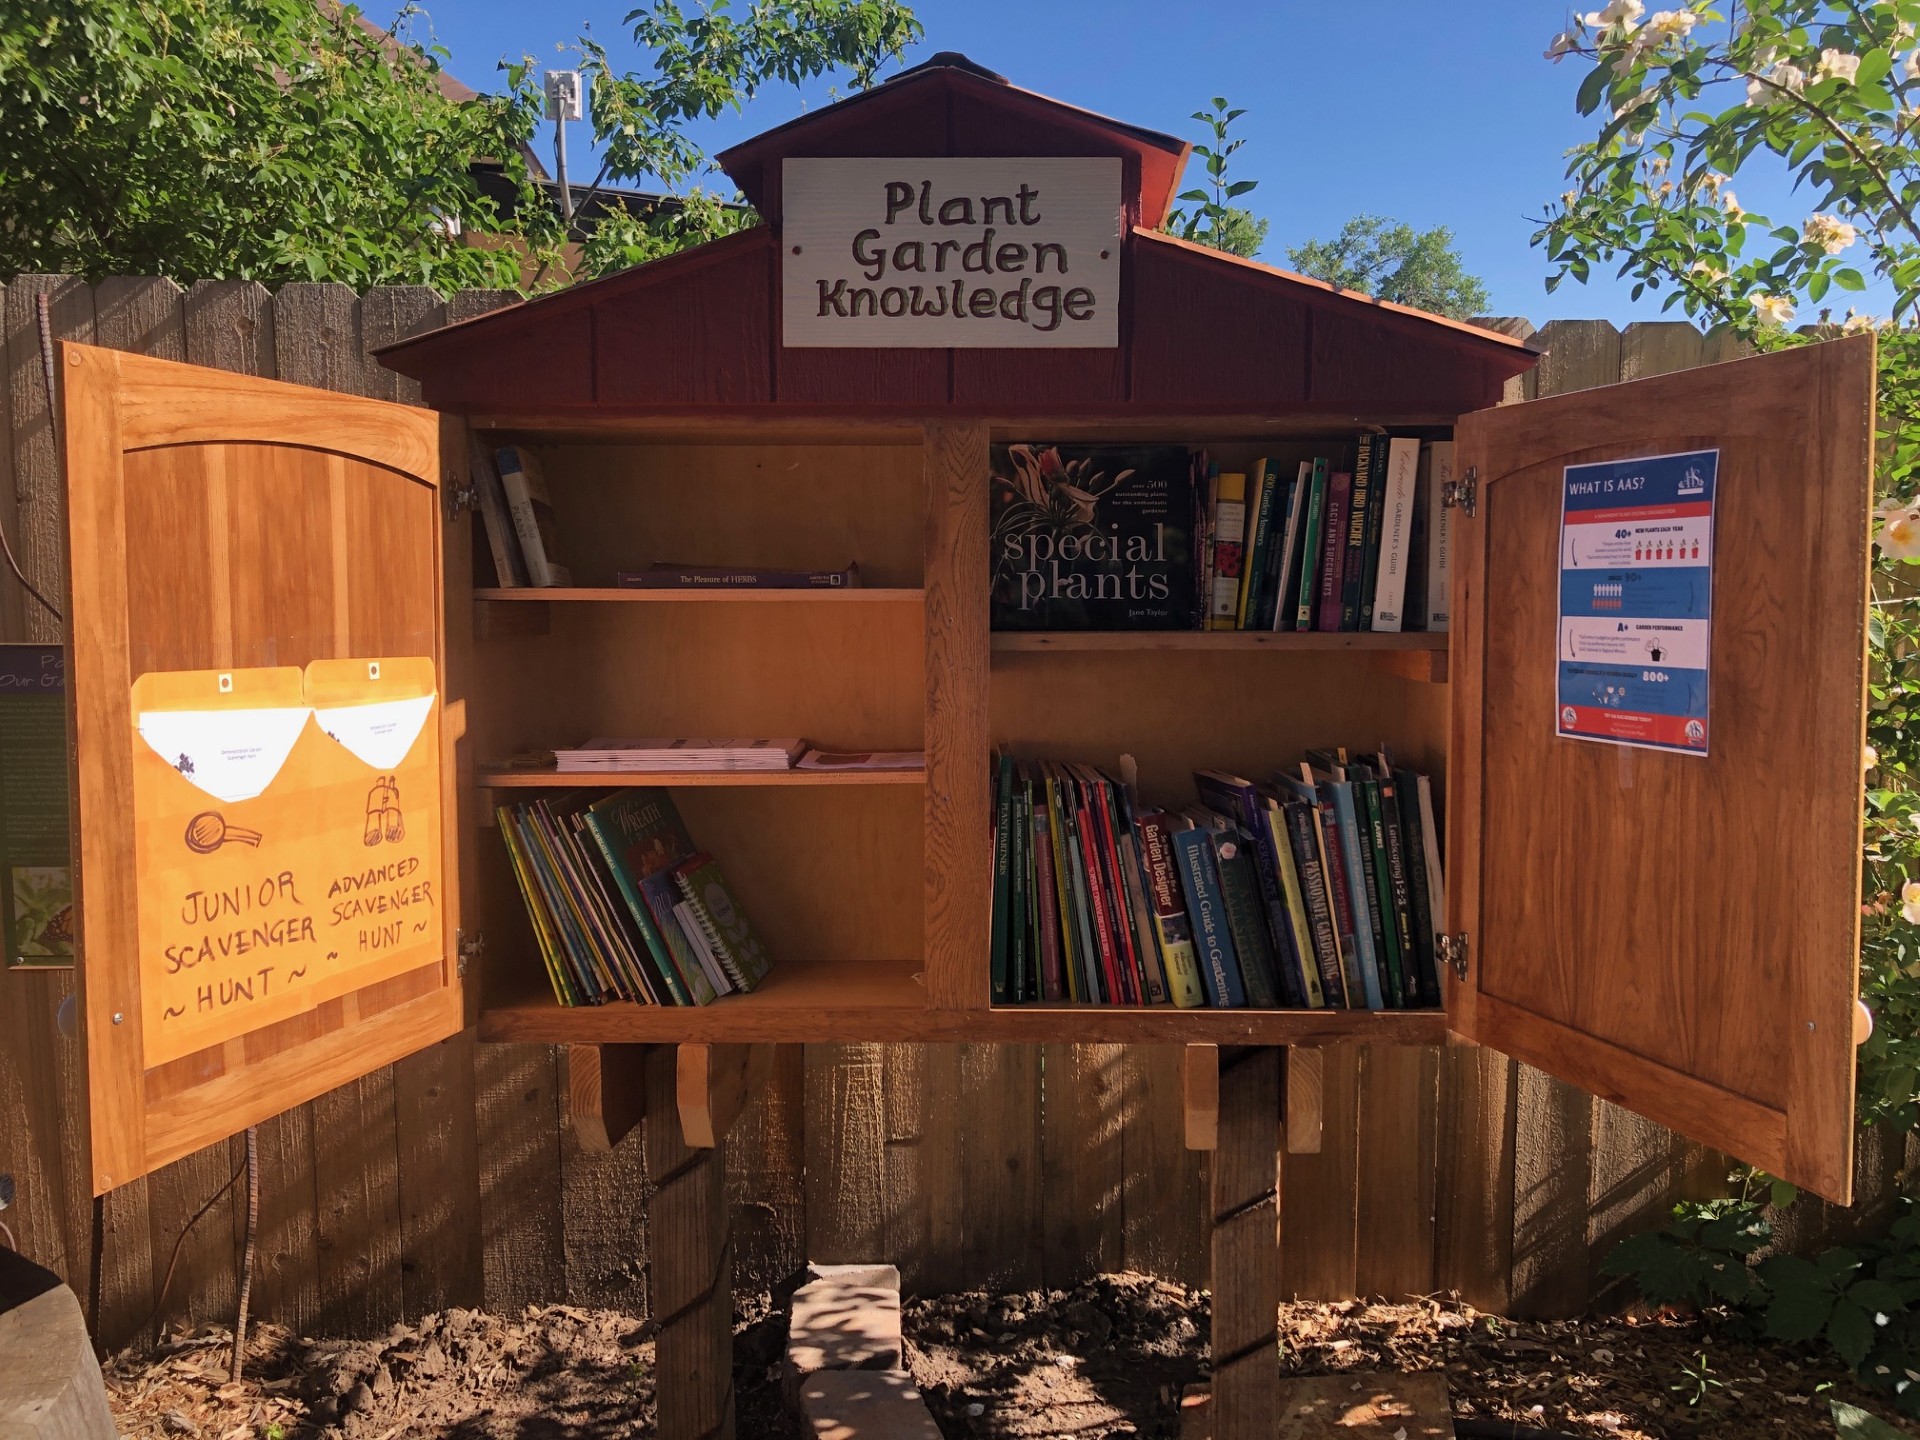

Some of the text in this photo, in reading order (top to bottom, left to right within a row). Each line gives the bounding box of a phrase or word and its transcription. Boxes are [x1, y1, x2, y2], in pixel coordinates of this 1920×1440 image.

[884, 180, 1041, 226] Plant
[852, 228, 1068, 281] Garden
[816, 277, 1096, 331] Knowledge
[1146, 480, 1168, 489] 500
[1353, 444, 1371, 487] BACKYARD
[1569, 477, 1645, 495] WHAT IS AAS?
[1255, 473, 1276, 546] 600 Garden Answers
[1352, 488, 1366, 508] BIRD
[1388, 450, 1410, 575] Colorado GARDENER'S GUIDE
[1004, 523, 1167, 572] special
[1321, 502, 1339, 596] CACTI AND SUCCULENTS
[1348, 510, 1365, 547] WATCHER
[1615, 529, 1632, 539] 40+
[680, 575, 757, 584] The Pleasure of HERBS
[1016, 560, 1169, 611] plants
[1128, 608, 1169, 617] Jane Taylor
[1617, 622, 1628, 632] A+
[1642, 671, 1670, 682] 800+
[612, 802, 662, 836] WREATH
[1374, 821, 1384, 849] LAWNS
[585, 816, 617, 869] GREAT WREATH IDEAS
[999, 832, 1007, 875] PARTNERS
[1160, 834, 1167, 843] So
[1164, 855, 1173, 871] Want
[1388, 823, 1406, 905] Landscaping 1-2-3
[328, 857, 420, 899] ADVANCED
[1087, 866, 1098, 891] BASICS
[1145, 824, 1174, 908] Garden Designer
[1255, 837, 1277, 897] XERISCAPE
[1326, 827, 1349, 933] BECOMING VEGETARIAN
[181, 870, 304, 926] JUNIOR
[329, 881, 435, 926] SCAVENGER
[1092, 891, 1105, 928] GROWING
[1304, 860, 1339, 979] PASSIONATE GARDENING
[359, 921, 402, 952] HUNT
[1186, 844, 1232, 1007] Illustrated Guide to Gardening
[1399, 912, 1408, 933] Zones
[164, 916, 318, 975] SCAVENGER
[198, 966, 275, 1013] HUNT
